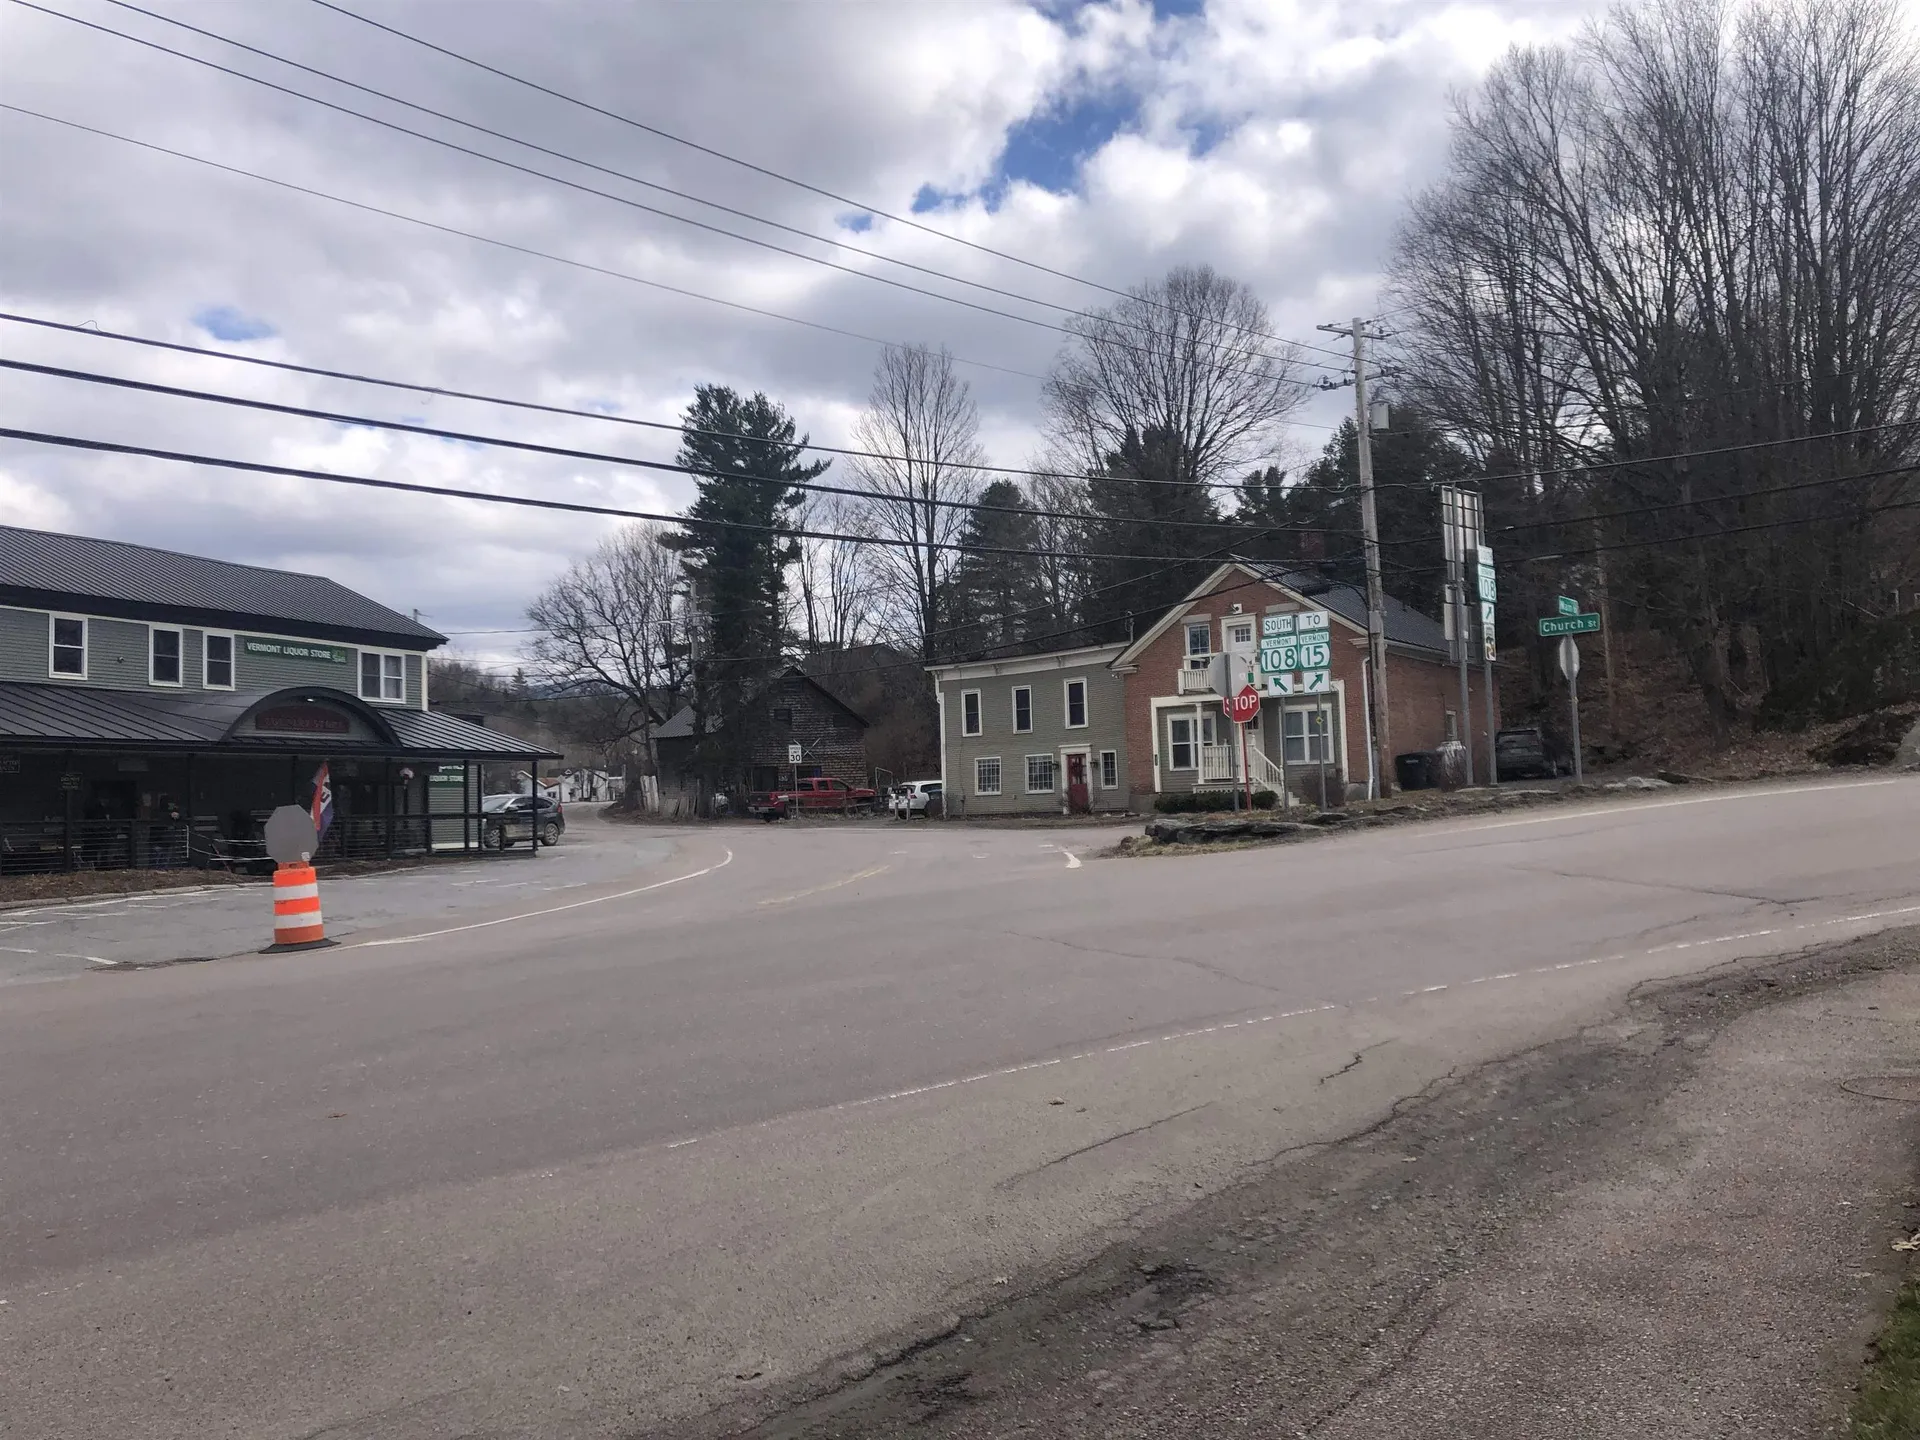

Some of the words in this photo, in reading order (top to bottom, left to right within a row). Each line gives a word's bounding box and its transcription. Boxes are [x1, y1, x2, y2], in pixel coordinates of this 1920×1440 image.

[1480, 578, 1496, 599] 108
[1265, 618, 1292, 631] SOUTH
[1306, 614, 1321, 626] TO
[1543, 619, 1584, 632] Church
[1266, 637, 1292, 647] VERMONT
[1301, 633, 1328, 643] VERMONT
[247, 642, 281, 653] VERMONT
[283, 646, 309, 657] LIQUOR
[310, 649, 331, 659] STORE
[1305, 645, 1325, 666] 15
[1263, 648, 1296, 670] 108
